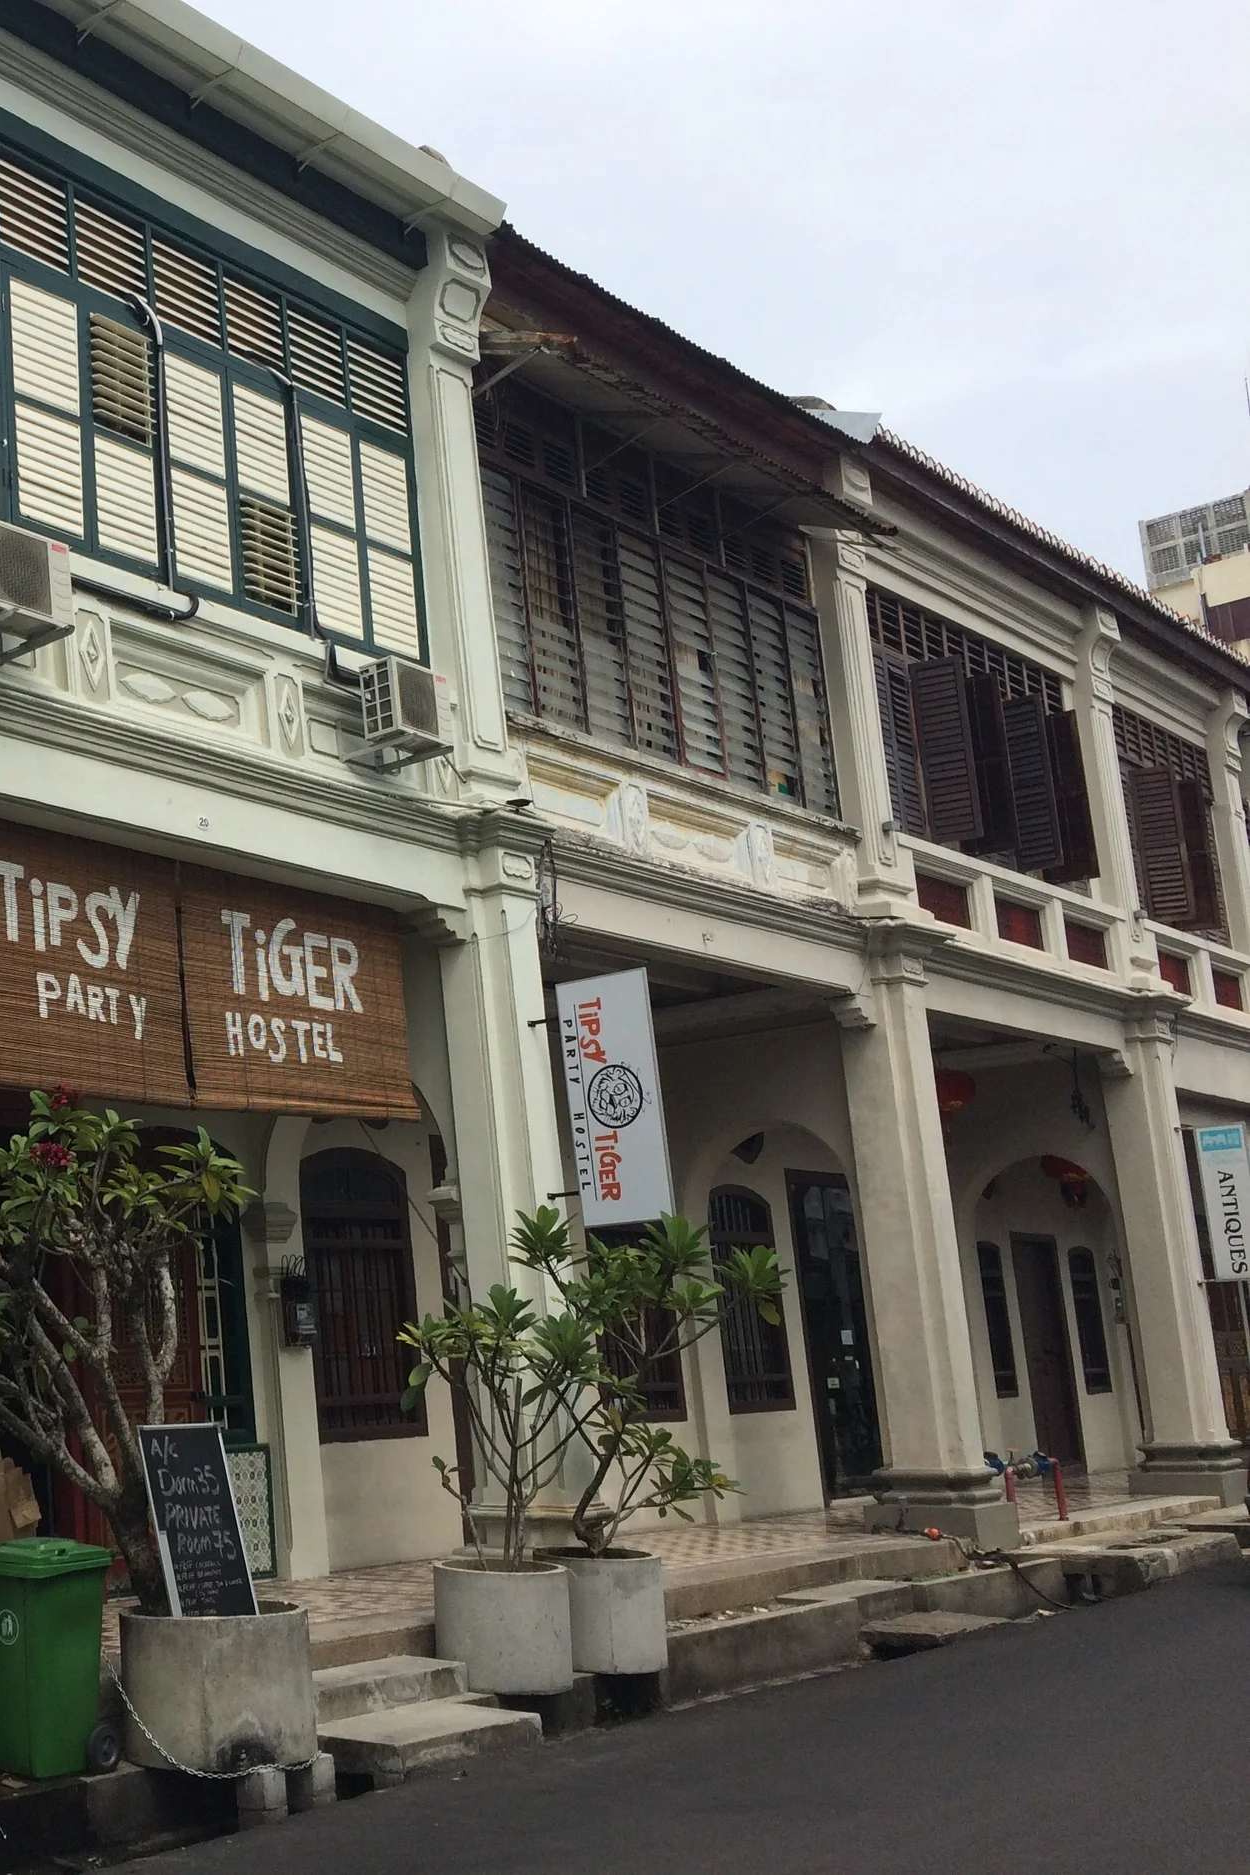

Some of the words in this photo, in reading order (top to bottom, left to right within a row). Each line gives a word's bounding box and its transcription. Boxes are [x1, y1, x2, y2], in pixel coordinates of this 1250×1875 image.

[36, 971, 147, 1040] PARTY
[226, 1011, 344, 1064] HOSTEL
[563, 1019, 581, 1085] PARTY
[573, 1112, 592, 1191] HOSTEL
[1217, 1170, 1248, 1275] ANTIQUES
[164, 1502, 222, 1530] PRIVATE
